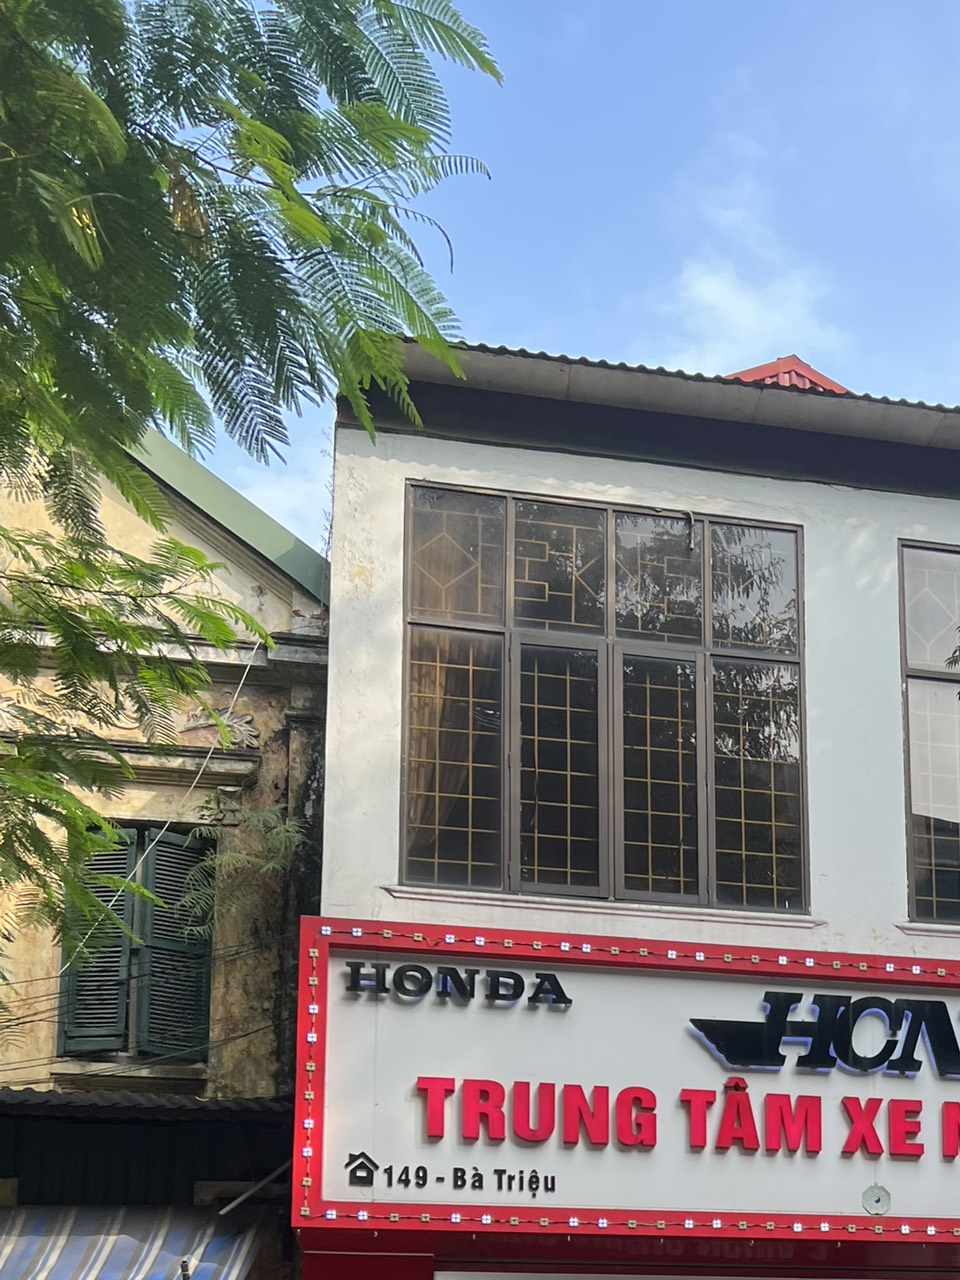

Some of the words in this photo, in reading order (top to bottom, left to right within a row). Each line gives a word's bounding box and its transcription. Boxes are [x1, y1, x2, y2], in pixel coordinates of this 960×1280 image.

[344, 961, 573, 1008] HONDA
[416, 1076, 658, 1148] TRUNG
[681, 1077, 823, 1154] TÂM
[841, 1096, 925, 1159] XE
[383, 1165, 429, 1189] 149
[453, 1166, 484, 1190] Bà
[493, 1168, 557, 1199] Triệu
